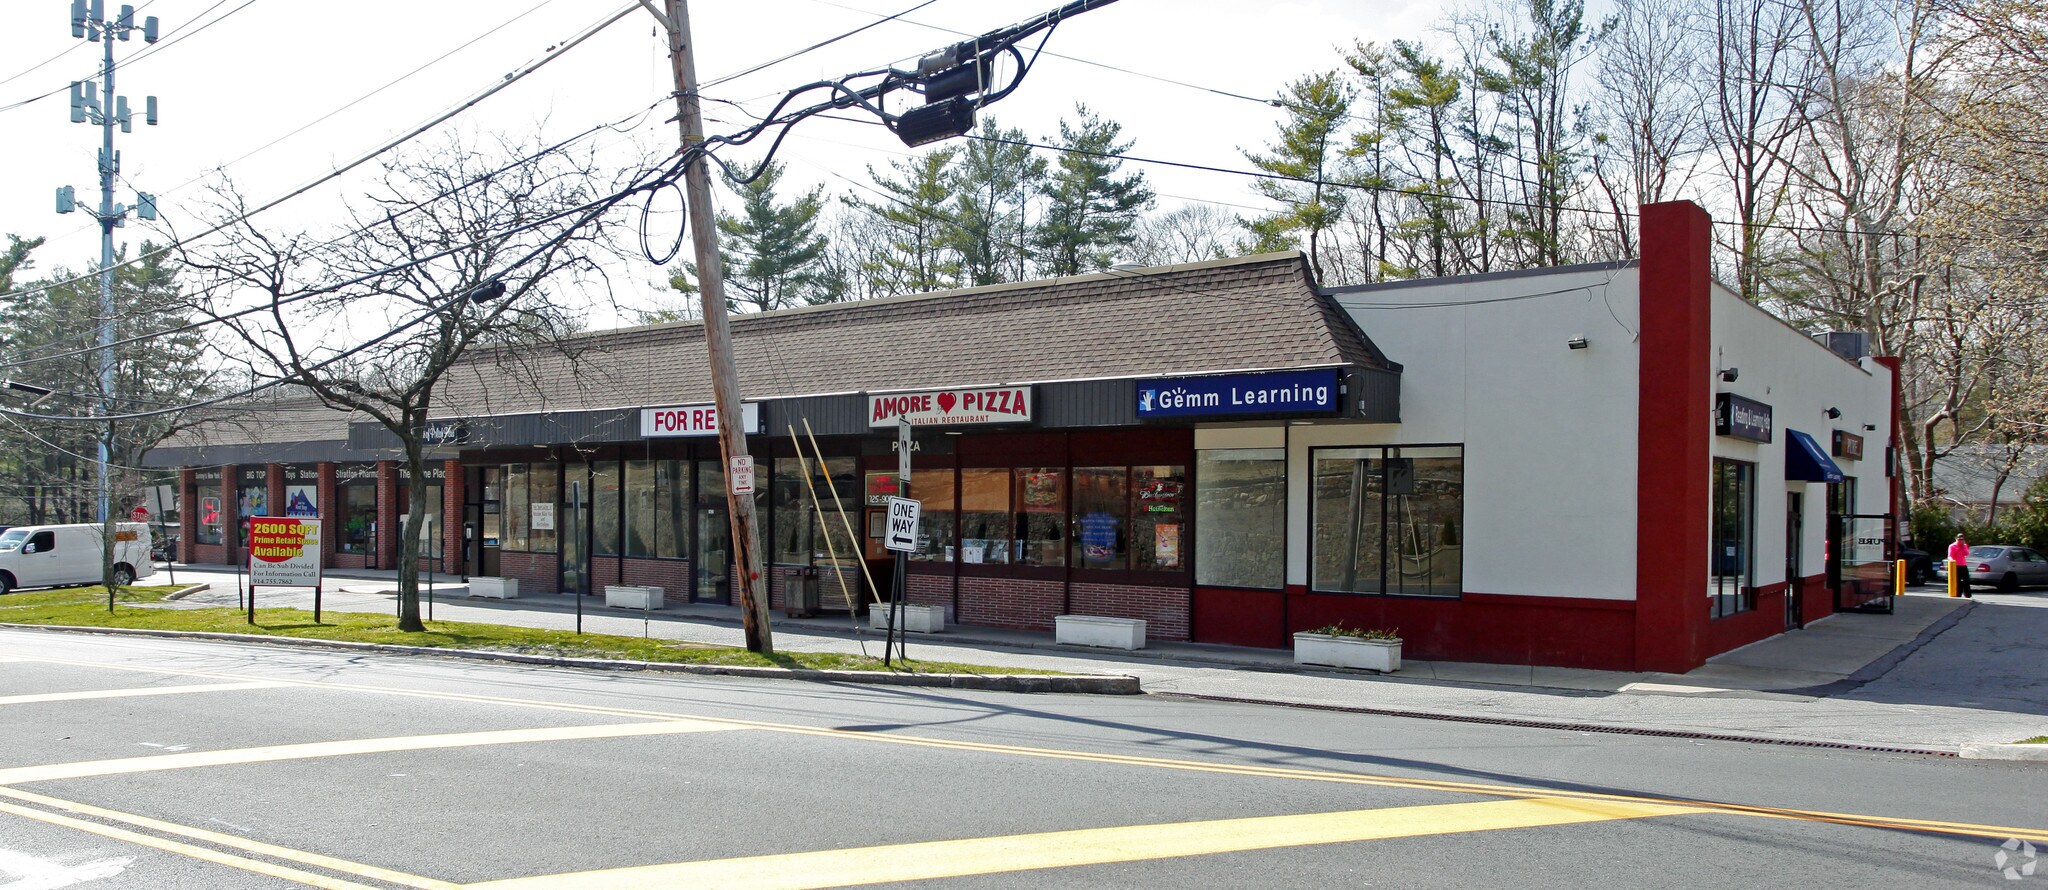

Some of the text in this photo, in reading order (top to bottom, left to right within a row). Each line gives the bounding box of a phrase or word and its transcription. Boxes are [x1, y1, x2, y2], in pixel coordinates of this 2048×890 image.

[1159, 384, 1327, 408] Gemm Learning
[872, 390, 1027, 422] AMORE PIZZA
[654, 410, 688, 431] FOR
[942, 415, 989, 424] RESTAURANT
[892, 441, 920, 451] PZA
[285, 471, 296, 480] Toys
[336, 470, 358, 478] Stratton
[399, 469, 410, 478] The
[894, 502, 914, 518] ONE
[254, 523, 318, 535] 2600 SQFT
[892, 518, 914, 533] WAY
[254, 546, 303, 557] Available
